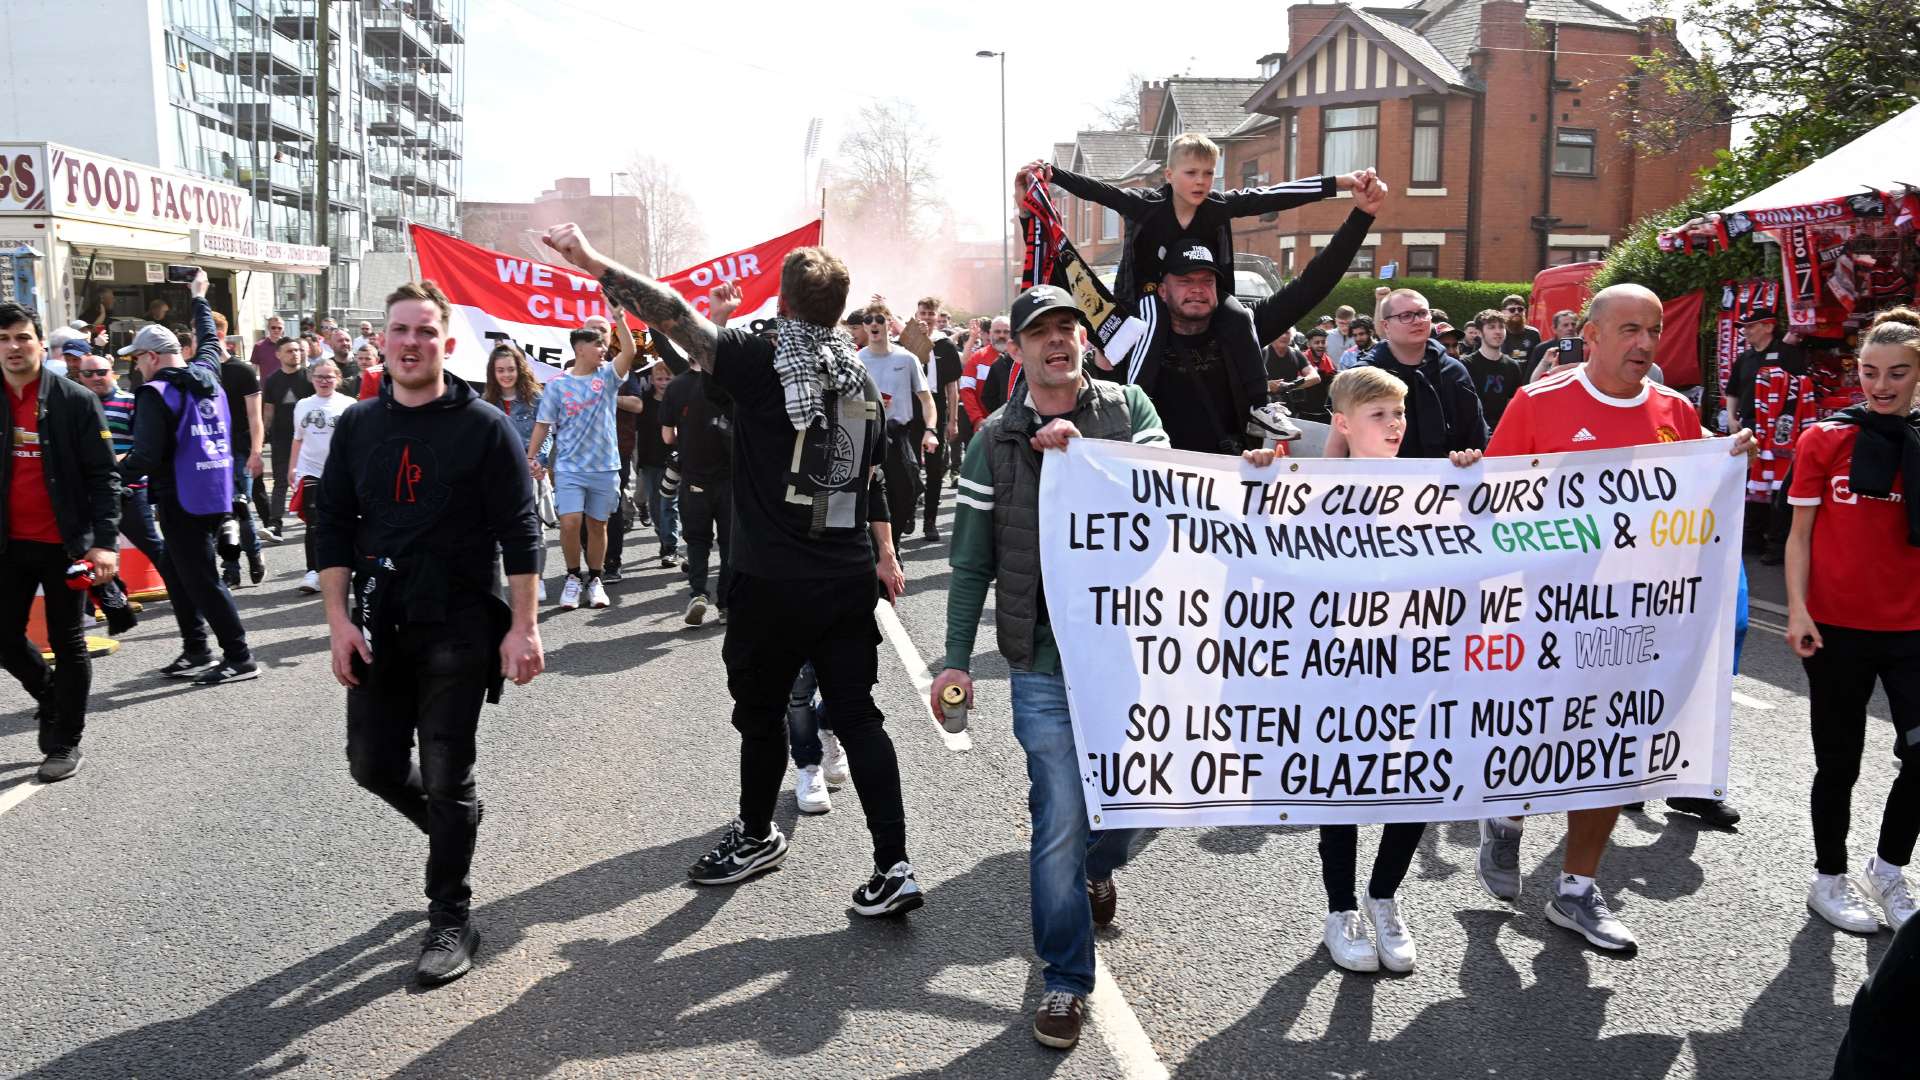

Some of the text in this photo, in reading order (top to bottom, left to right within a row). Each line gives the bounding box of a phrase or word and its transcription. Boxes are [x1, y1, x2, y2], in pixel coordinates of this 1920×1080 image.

[64, 158, 242, 230] FOOD FACTORY
[1755, 203, 1843, 224] RONALDO
[495, 258, 553, 287] WE
[689, 253, 762, 287] OUR
[205, 439, 228, 454] 25
[1133, 467, 1676, 515] UNTIL THIS CLUB OF OURS IS SOLD
[1070, 508, 1720, 560] LETS TURN MANCHESTER GREEN & GOLD.
[1089, 577, 1702, 629] THIS IS OUR CLUB AND WE SHALL FIGHT
[1136, 625, 1660, 679] TO ONCE AGAIN BE RED & WHITE.
[1126, 689, 1664, 746] SO LISTEN CLOSE IT MUST BE SAID
[1191, 751, 1263, 794] OFF
[1281, 748, 1464, 801] GLAZERS,
[1483, 732, 1638, 790] GOODBYE
[1647, 730, 1690, 774] ED.
